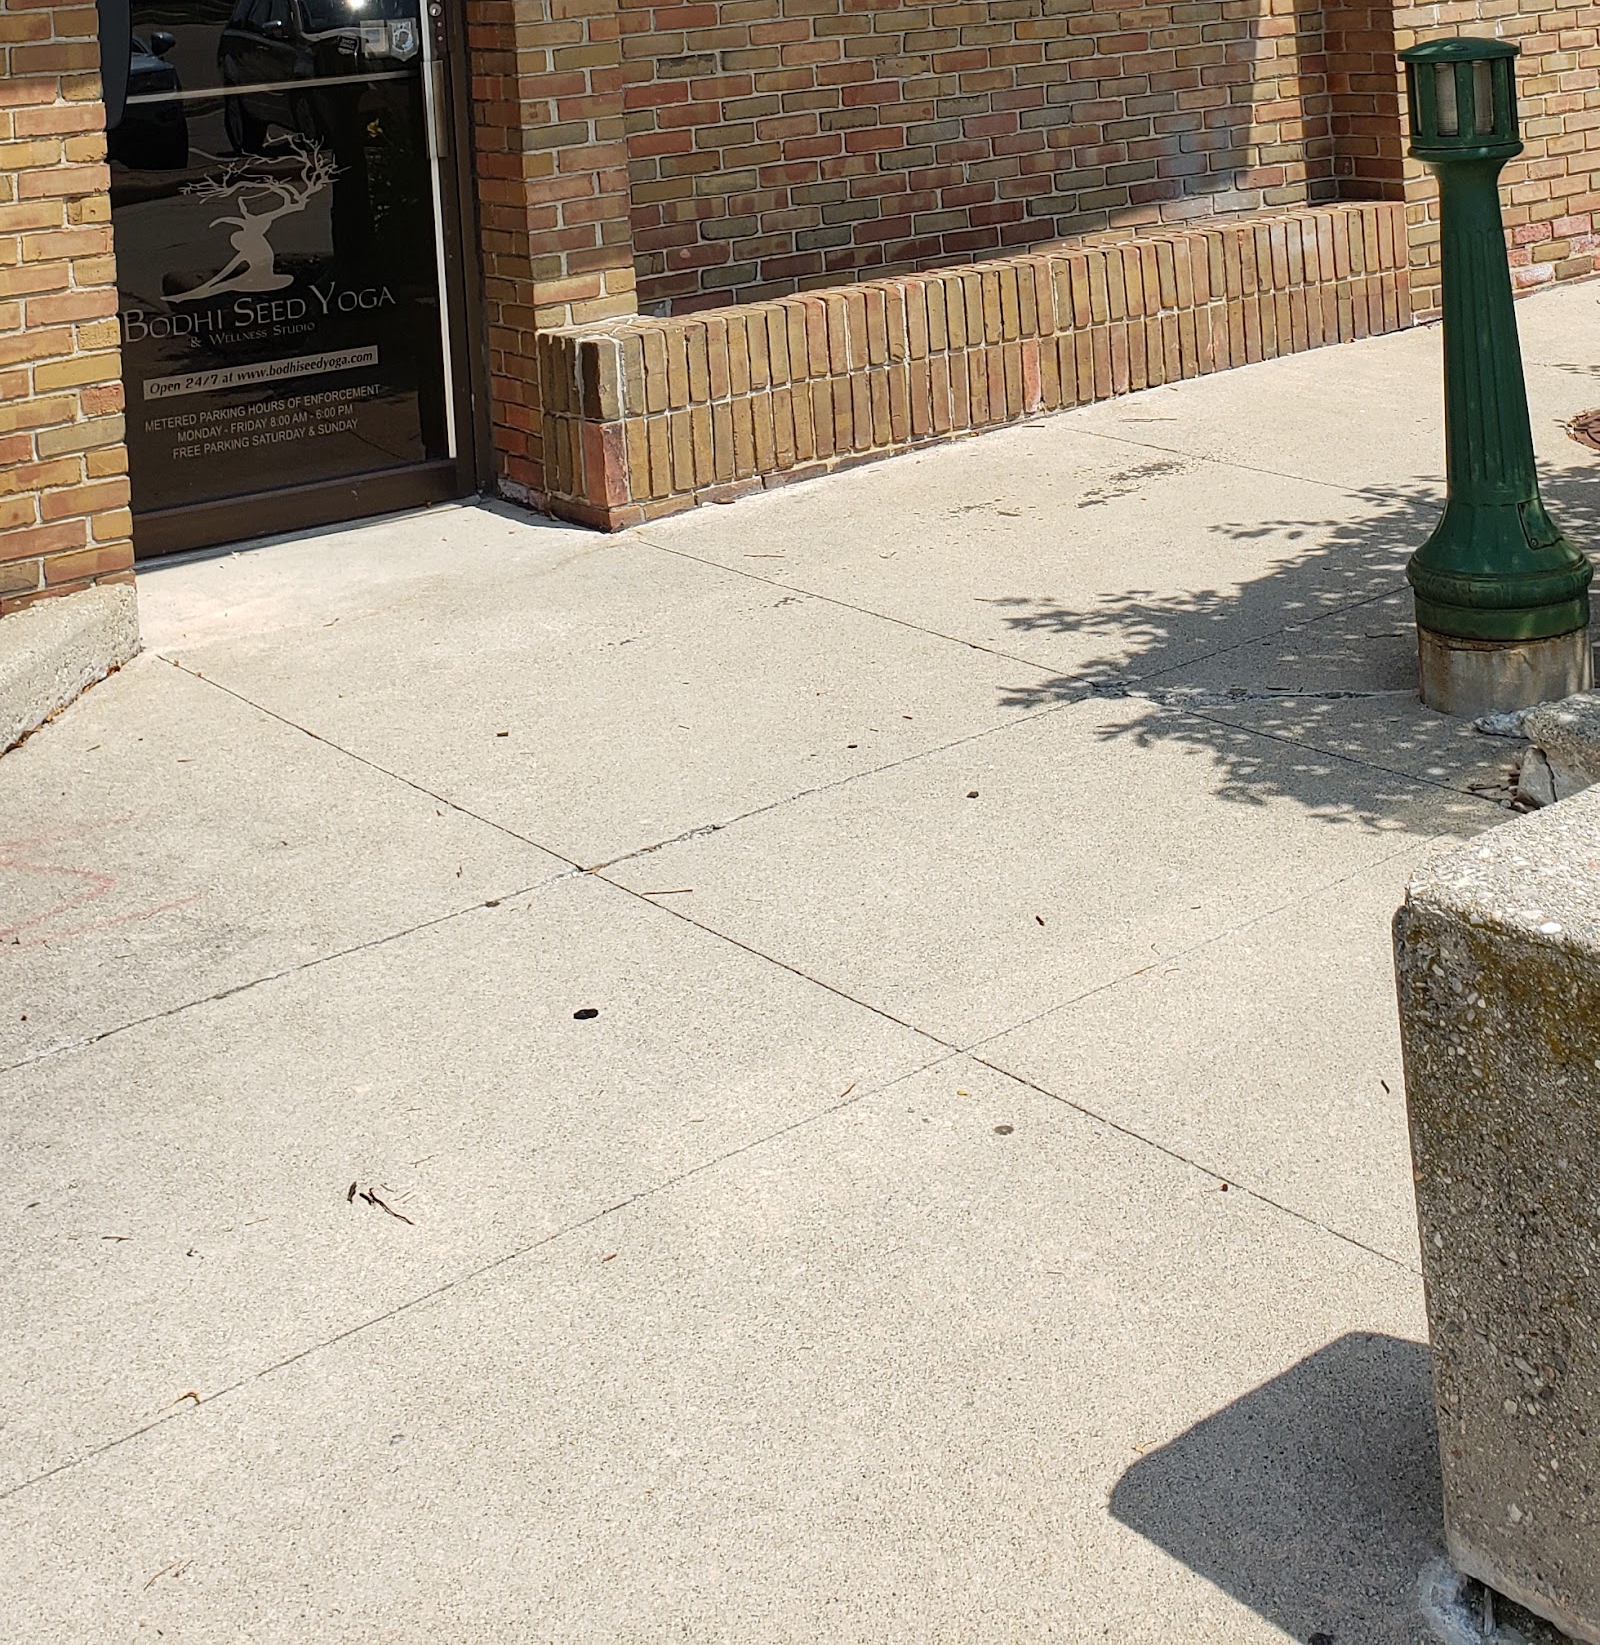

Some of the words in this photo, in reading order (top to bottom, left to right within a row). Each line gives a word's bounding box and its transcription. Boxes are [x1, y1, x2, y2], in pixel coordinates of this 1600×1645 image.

[122, 309, 222, 343] BODHI
[233, 298, 306, 326] SEED
[308, 282, 396, 314] YOGA
[190, 336, 202, 348] &
[209, 330, 267, 345] WELLNESS
[273, 322, 315, 336] STUDIO
[150, 382, 181, 395] Open
[186, 374, 218, 389] 24/7
[222, 373, 233, 383] at
[237, 352, 372, 379] www.bodhiseedyoga.com
[145, 414, 196, 433] METERED
[200, 406, 245, 423] PARKING
[248, 399, 285, 416] HOURS
[287, 397, 301, 408] OF
[304, 384, 380, 406] ENFORCEMENT
[178, 425, 222, 442] MONDAY
[231, 418, 268, 433] FRIDAY
[292, 411, 307, 424] AM
[316, 407, 335, 419] 6:00
[338, 404, 353, 415] PM
[173, 445, 201, 459] FREE
[204, 437, 249, 454] PARKING
[252, 427, 306, 446] SATURDAY
[308, 426, 315, 436] &
[318, 418, 358, 434] SUNDAY
